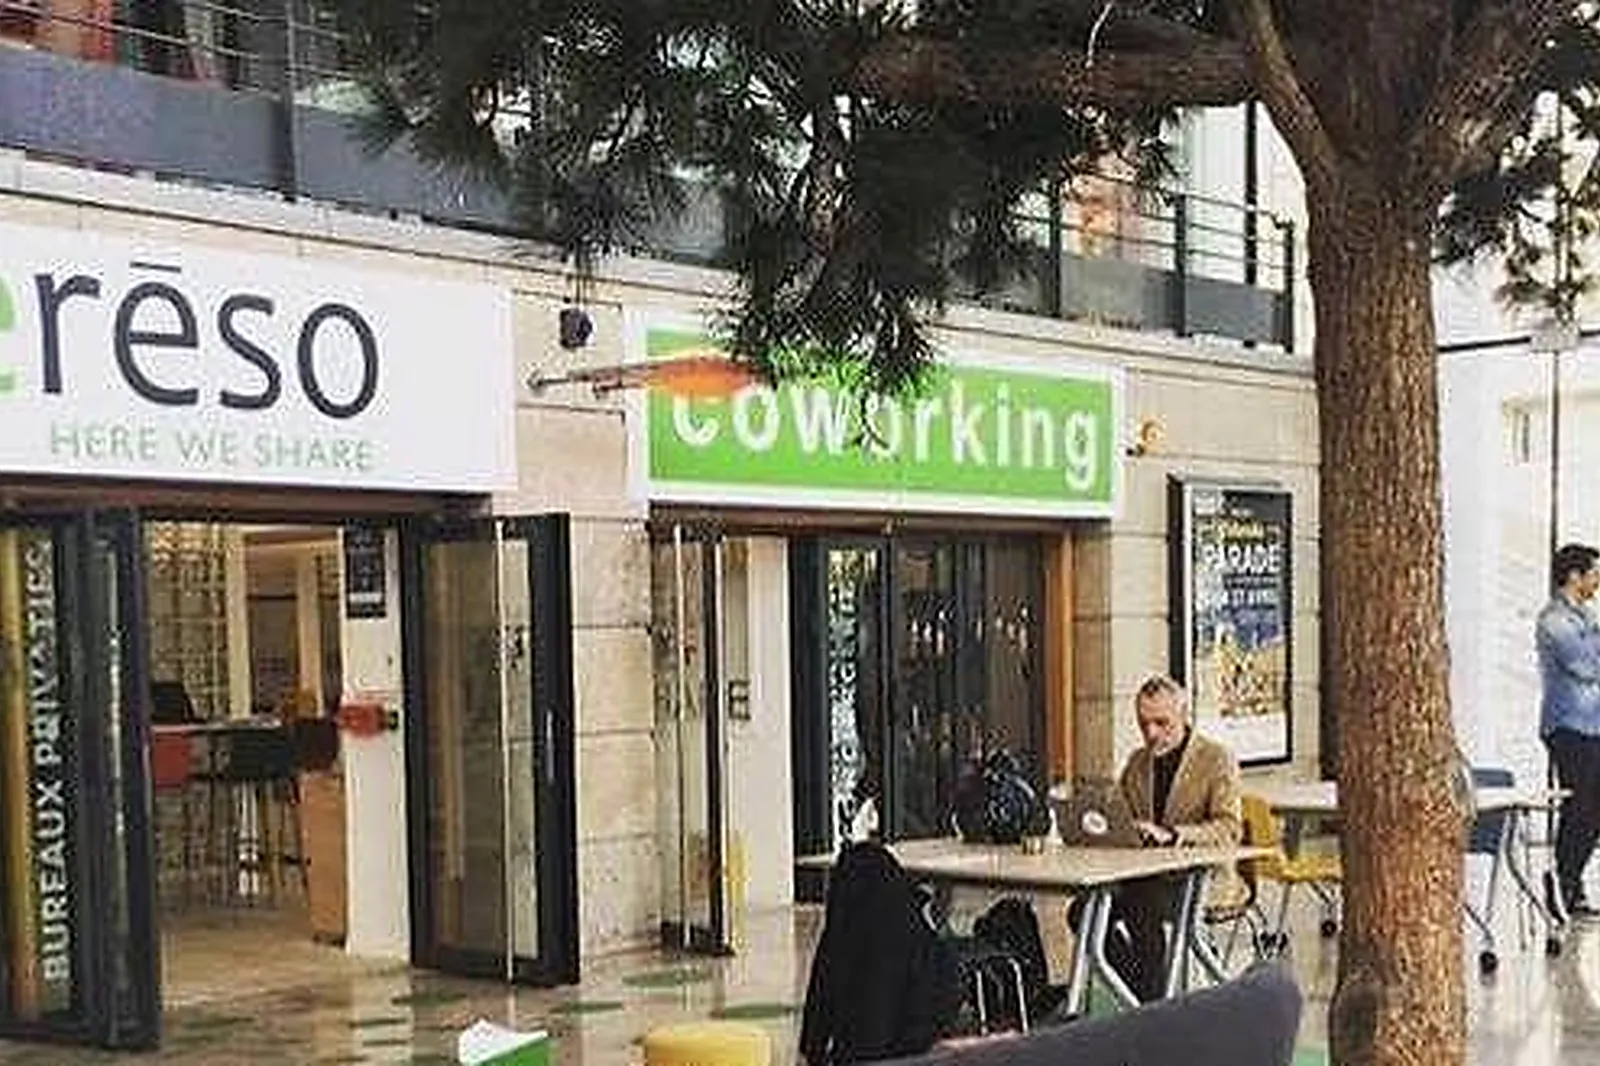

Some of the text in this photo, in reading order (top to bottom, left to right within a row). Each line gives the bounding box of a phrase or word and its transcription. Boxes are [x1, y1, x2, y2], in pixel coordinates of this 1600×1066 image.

[51, 421, 376, 471] HERE WE SHARE
[35, 778, 70, 982] BUREAUX
